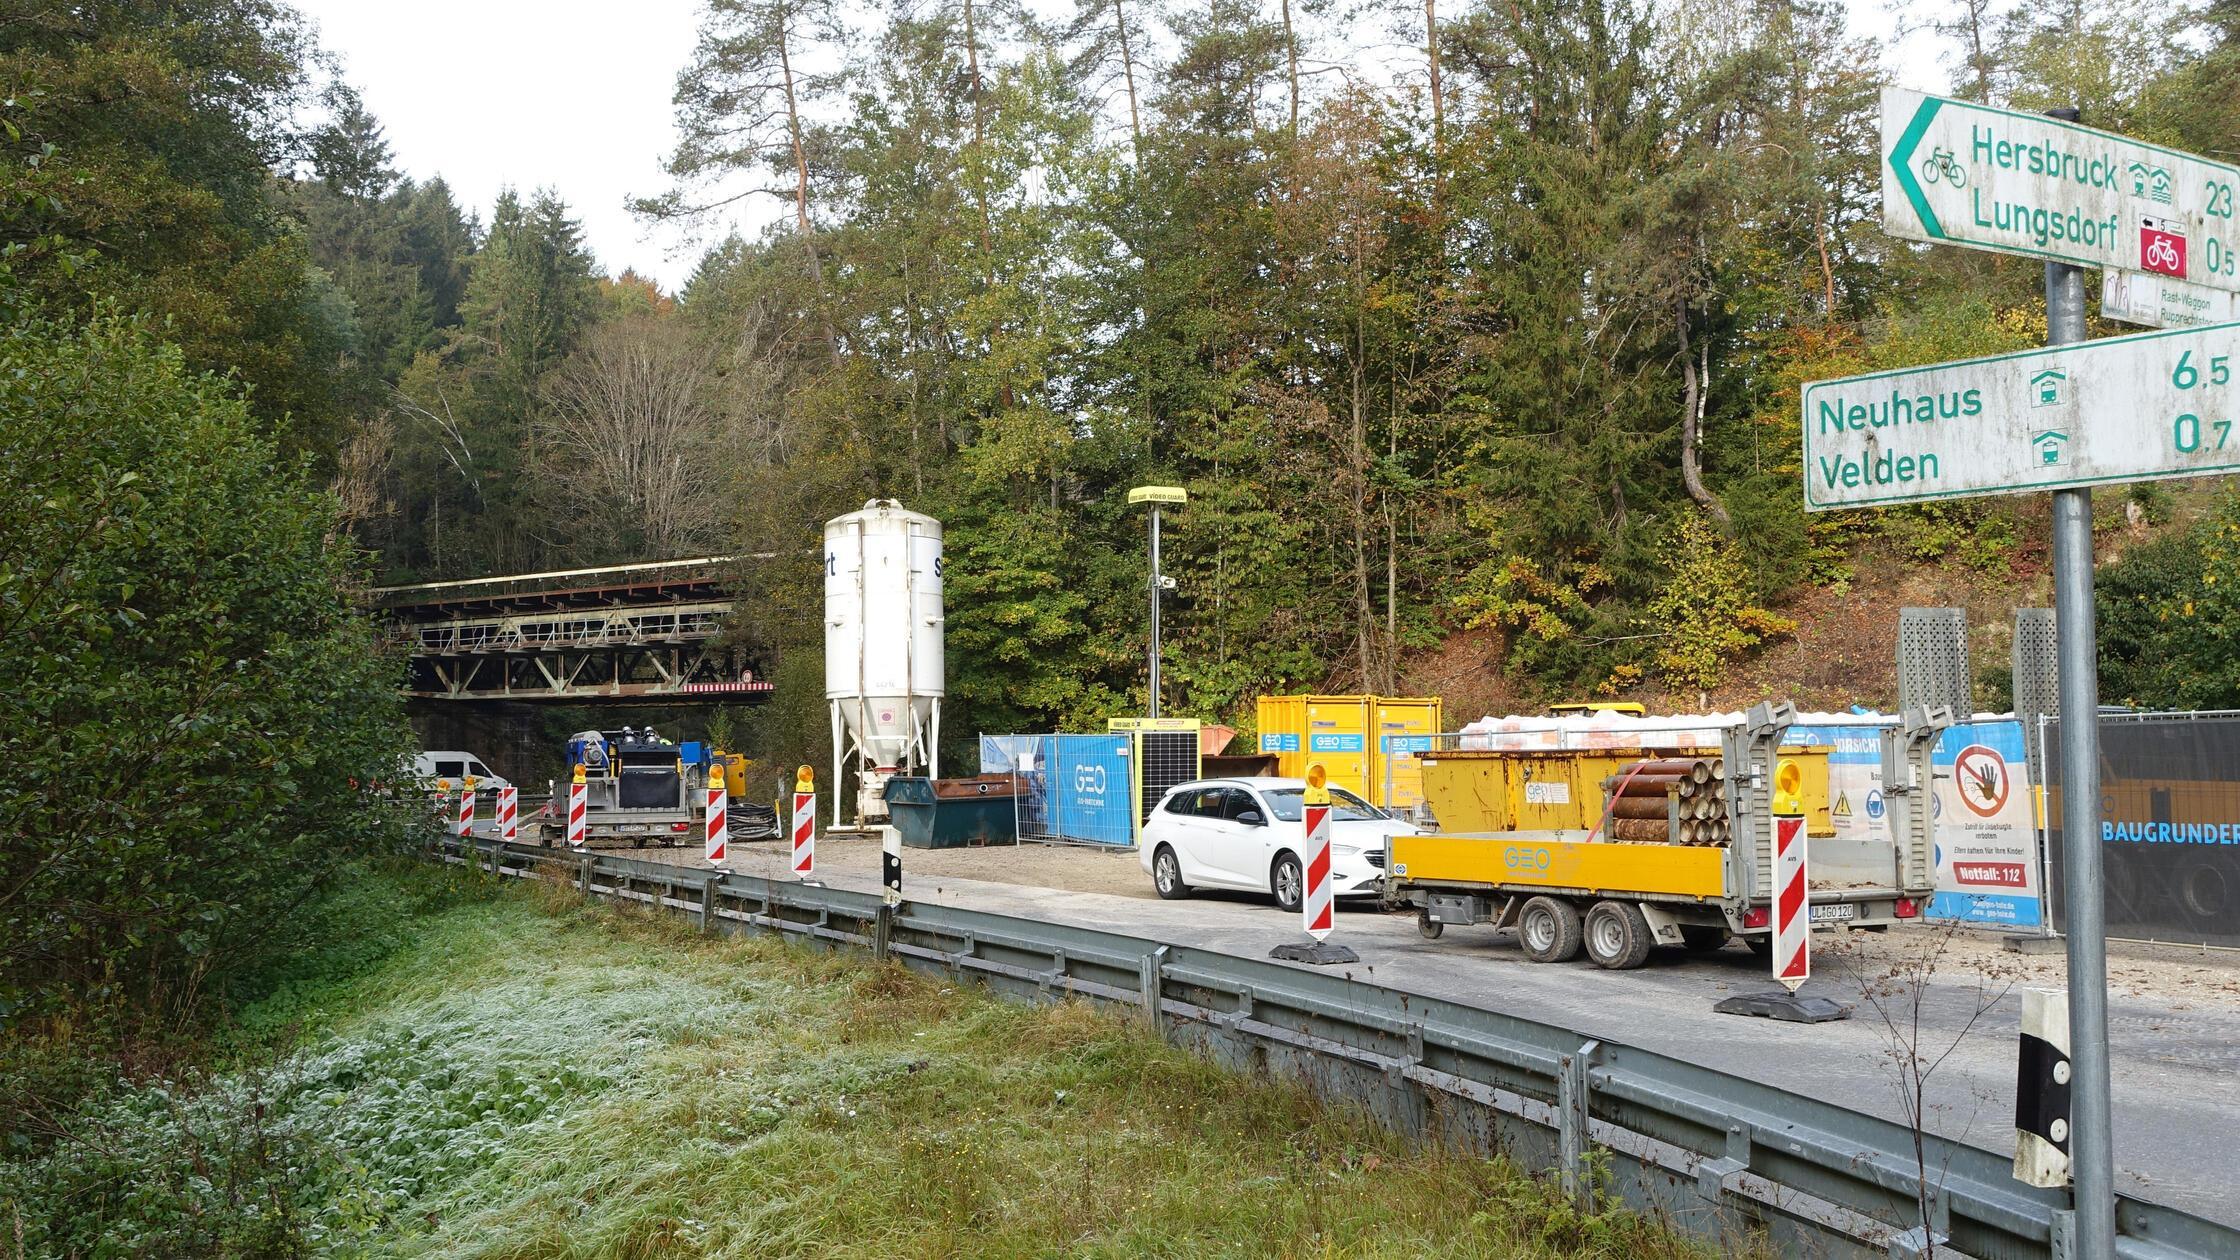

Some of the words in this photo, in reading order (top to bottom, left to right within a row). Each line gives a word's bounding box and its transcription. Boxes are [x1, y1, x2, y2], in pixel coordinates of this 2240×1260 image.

[1972, 124, 2119, 192] Hersbruck
[2205, 180, 2233, 220] 23
[1973, 187, 2118, 251] Lungsdorf
[2160, 219, 2166, 232] 5
[2161, 289, 2211, 311] Rast-Waggon
[1819, 388, 1983, 435] Neuhaus
[2171, 349, 2230, 391] 6,5
[1819, 447, 1939, 490] Velden
[2174, 413, 2232, 454] 0,7
[1265, 734, 1281, 746] GEO
[1316, 736, 1339, 747] GEO
[1075, 764, 1106, 795] GEO
[1527, 784, 1548, 800] geo
[1504, 847, 1551, 870] GEO
[1959, 867, 2001, 881] Notfall:
[2002, 868, 2020, 882] 112
[1812, 907, 1822, 919] UL
